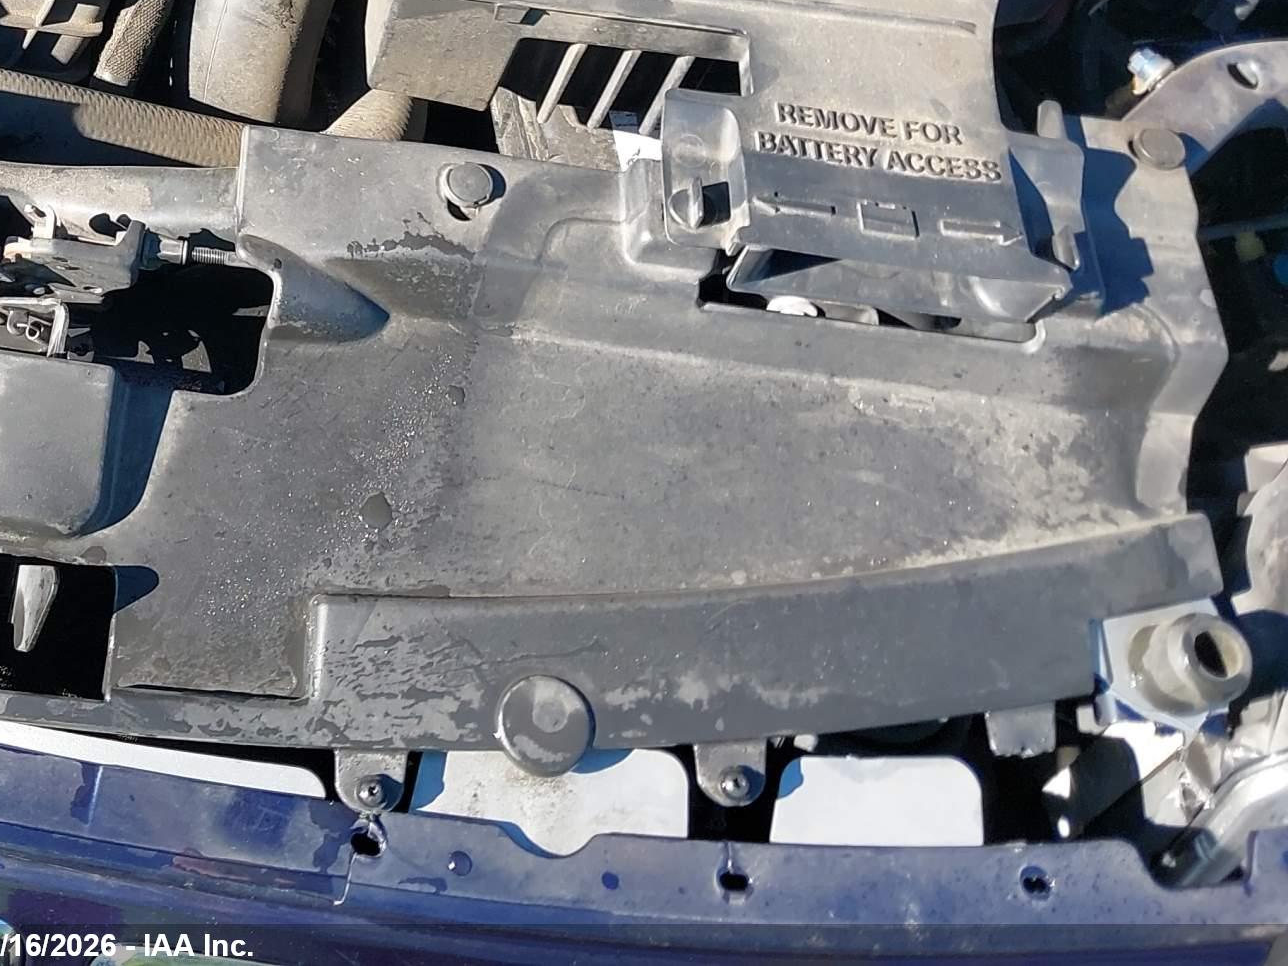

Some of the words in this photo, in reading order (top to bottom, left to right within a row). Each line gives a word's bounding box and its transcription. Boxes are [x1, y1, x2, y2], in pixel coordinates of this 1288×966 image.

[774, 102, 899, 138] REMOVE
[902, 120, 963, 146] FOR
[754, 130, 879, 169] BATTERY
[882, 149, 1003, 183] ACCESS
